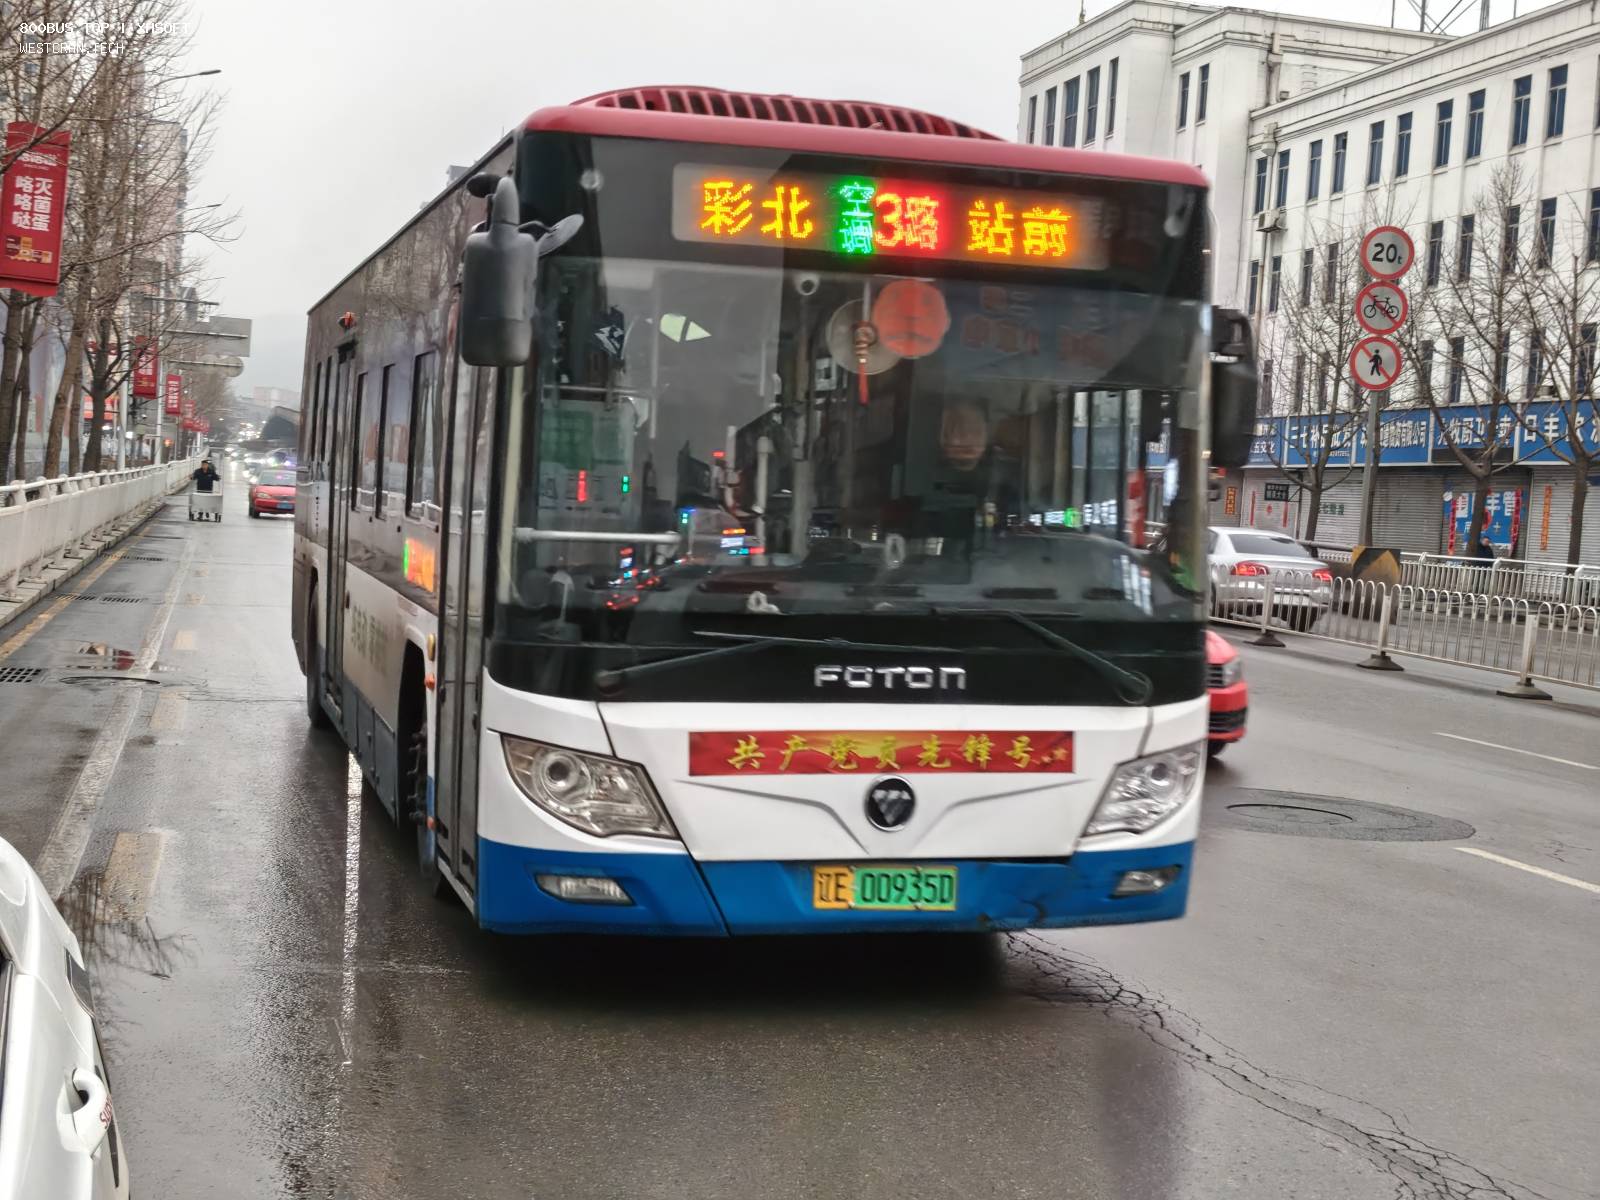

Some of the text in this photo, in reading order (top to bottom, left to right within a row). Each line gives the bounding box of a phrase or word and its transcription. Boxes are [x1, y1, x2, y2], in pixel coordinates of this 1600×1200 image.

[31, 177, 54, 232] 灭菌蛋
[701, 180, 1071, 257] 彩北 空调 3路 站前
[814, 664, 967, 690] FOTON
[727, 733, 1034, 771] 共产党员先锋号
